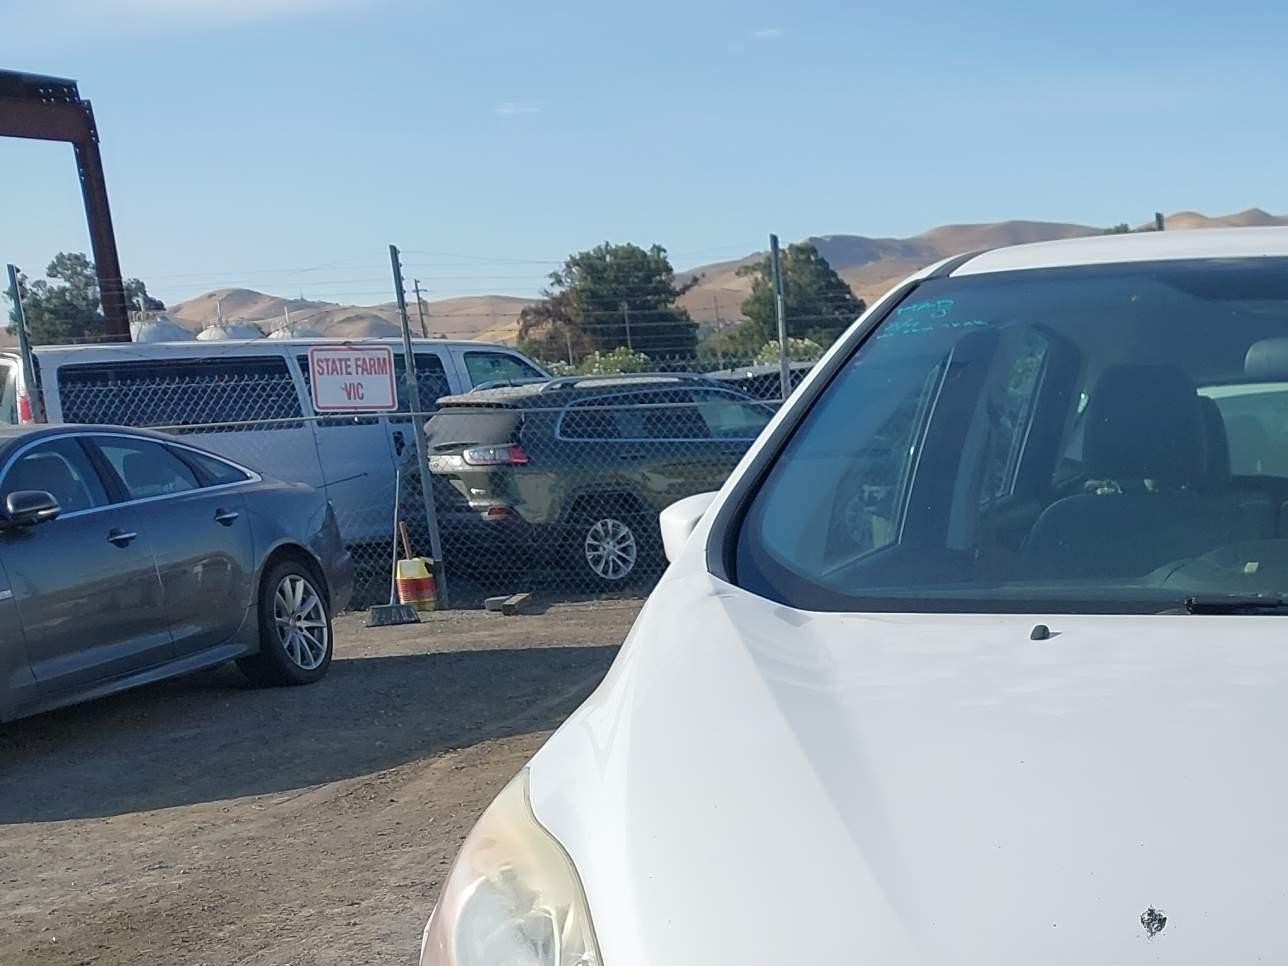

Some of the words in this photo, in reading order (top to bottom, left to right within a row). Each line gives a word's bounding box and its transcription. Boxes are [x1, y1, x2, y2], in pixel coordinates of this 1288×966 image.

[316, 357, 352, 375] STATE
[355, 357, 388, 375] FARM
[343, 382, 365, 401] VIC
